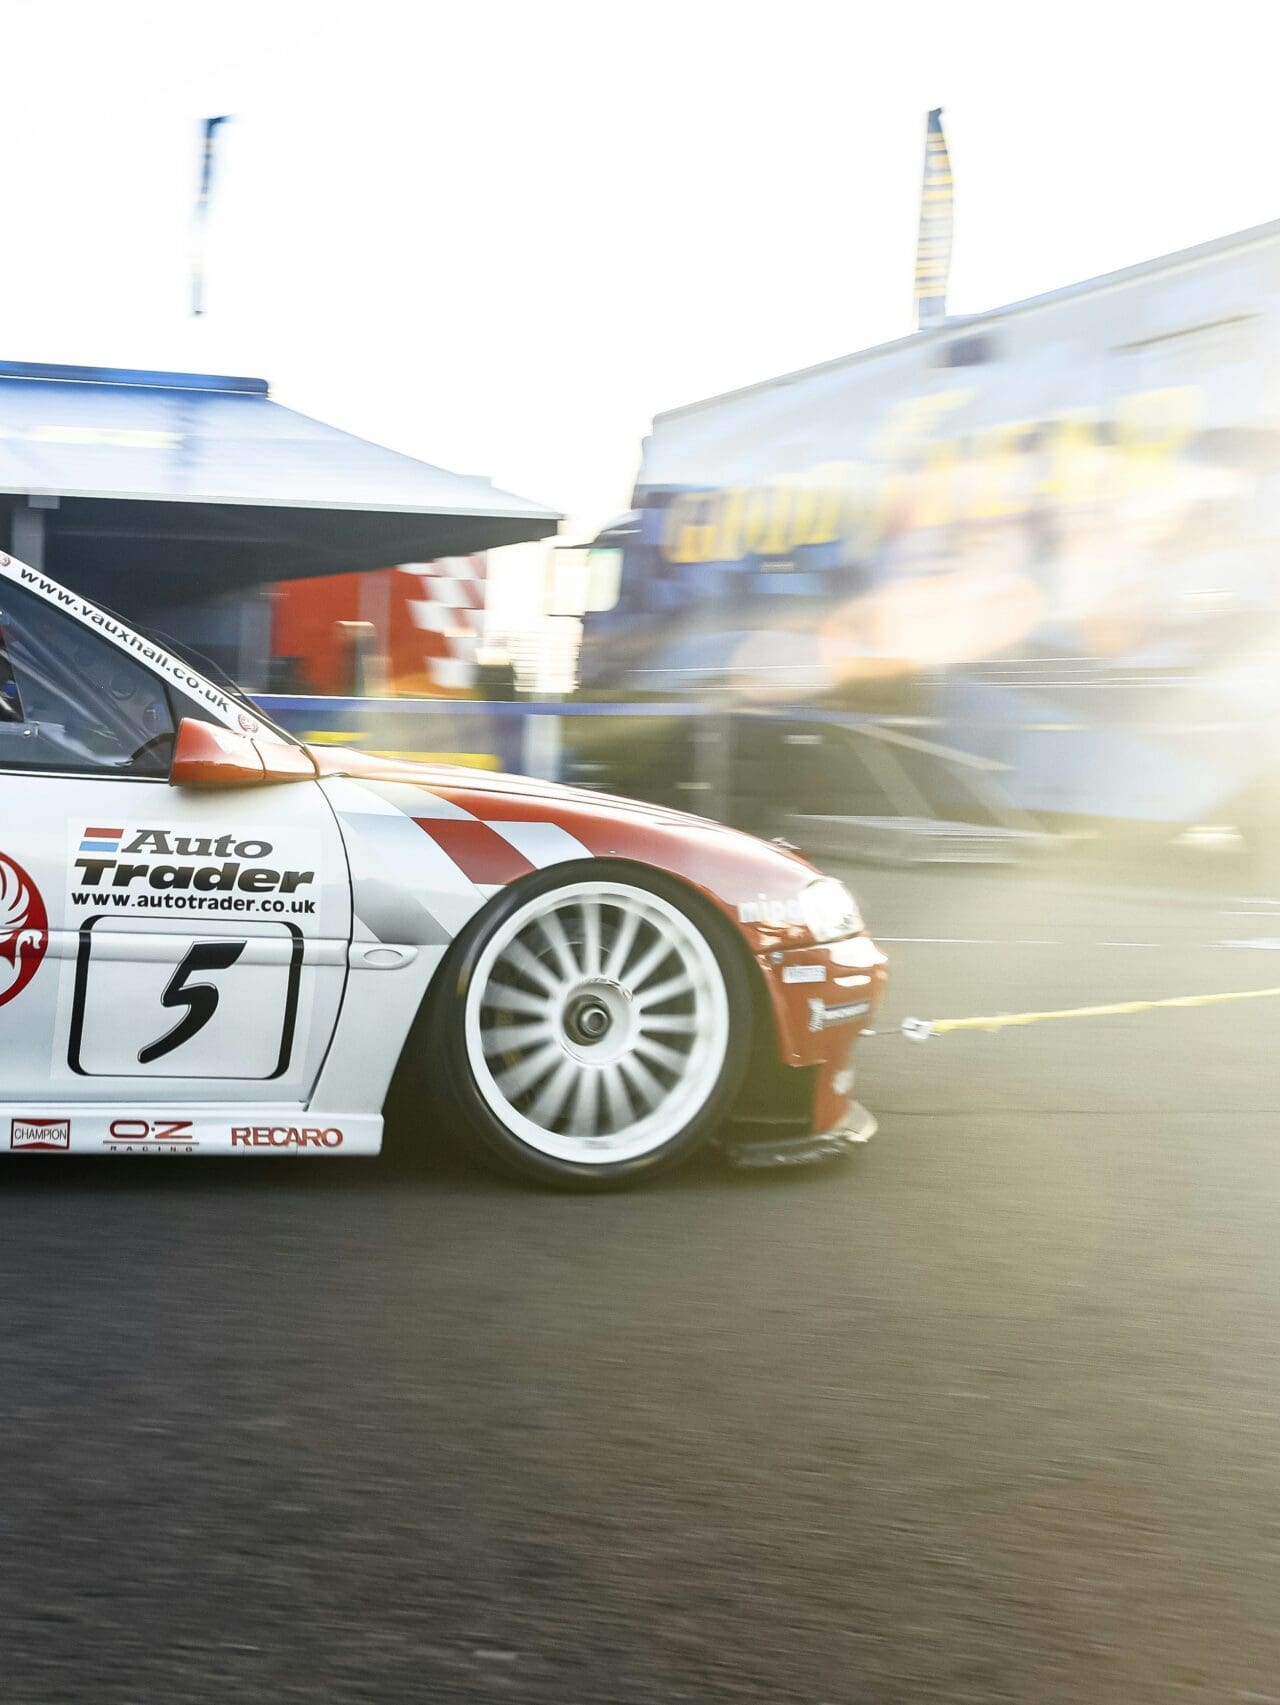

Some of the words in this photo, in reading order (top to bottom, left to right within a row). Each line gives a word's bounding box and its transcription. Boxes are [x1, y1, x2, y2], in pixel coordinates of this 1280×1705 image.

[20, 567, 230, 713] www.vauxhall.co.uk
[121, 829, 274, 859] Auto
[74, 858, 315, 894] Trader
[71, 891, 316, 914] www.autotrader.co.uk
[137, 940, 248, 1064] 5
[14, 1127, 68, 1141] CHAMPION
[231, 1126, 344, 1148] RECARO
